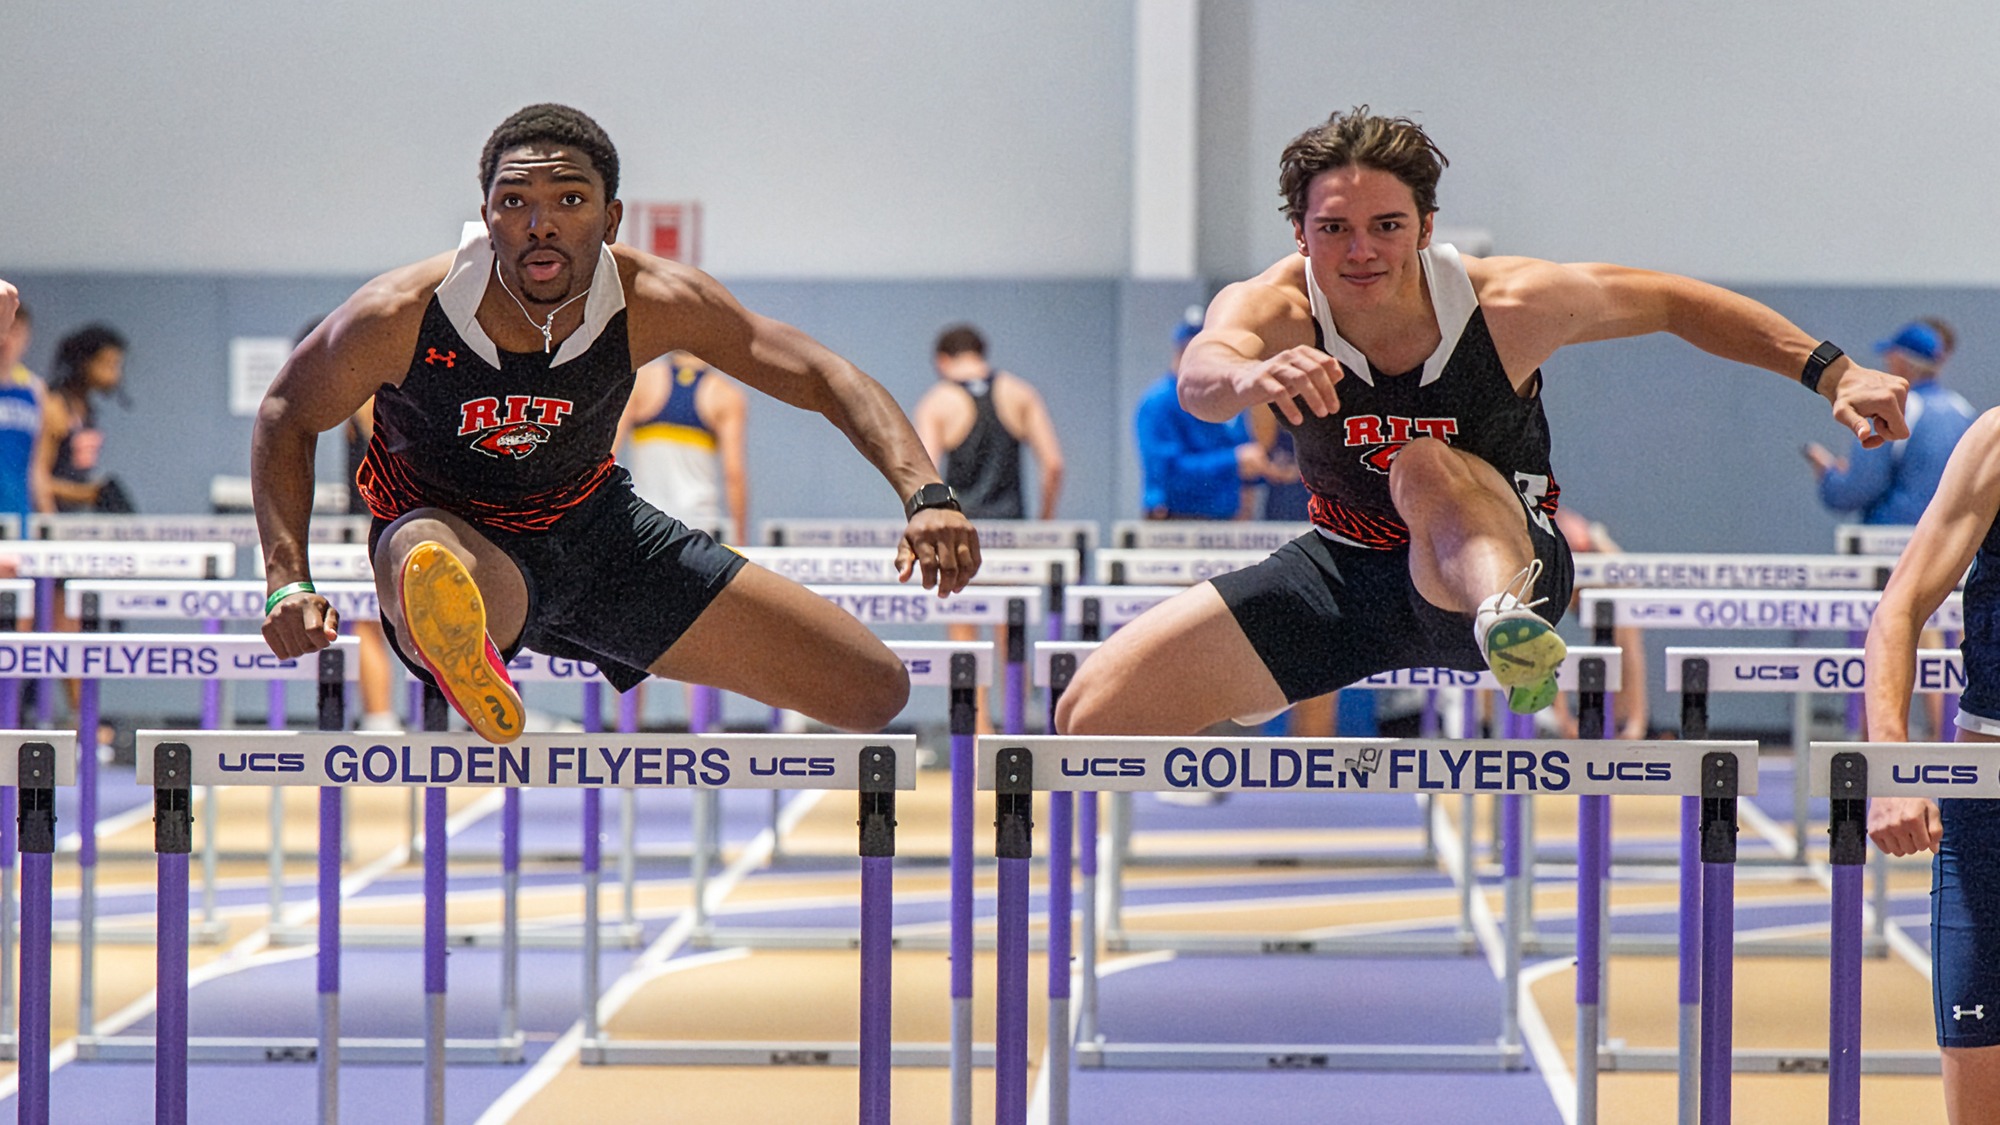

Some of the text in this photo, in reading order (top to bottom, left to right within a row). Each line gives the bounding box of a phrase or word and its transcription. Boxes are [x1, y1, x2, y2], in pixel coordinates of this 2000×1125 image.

[457, 395, 574, 436] RIT
[1344, 414, 1459, 447] RIT
[180, 591, 265, 617] GOLD
[1694, 600, 1818, 627] GOLDEN
[83, 646, 219, 674] FLYERS
[234, 654, 298, 669] UCS
[1735, 658, 1968, 689] UCS GOEN
[218, 744, 835, 786] UCS GOLDEN FLYERS UCS
[1061, 747, 1672, 791] UCS GOLDEN FLYERS UCS
[1892, 764, 1979, 785] UCS
